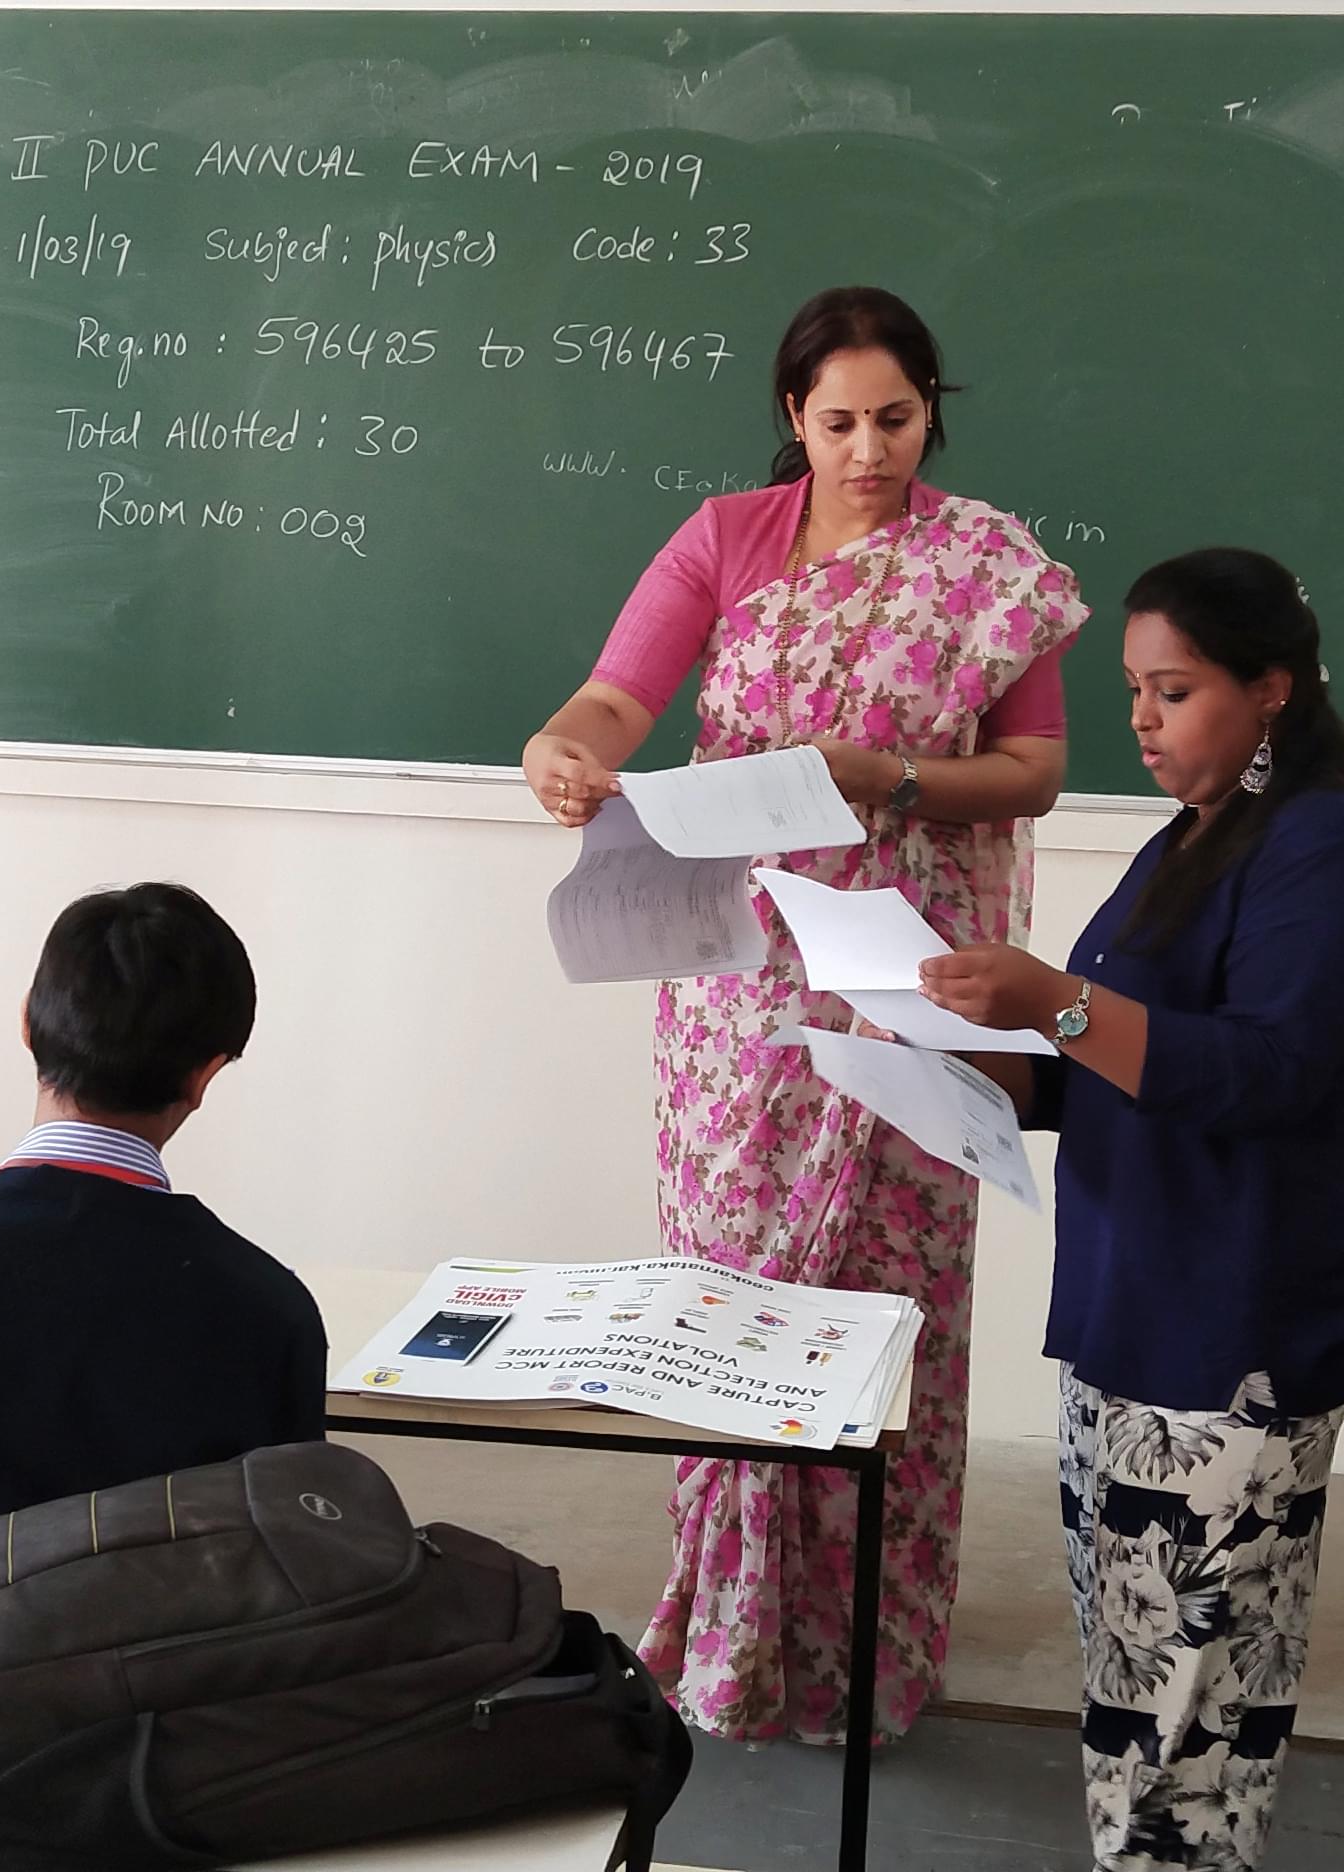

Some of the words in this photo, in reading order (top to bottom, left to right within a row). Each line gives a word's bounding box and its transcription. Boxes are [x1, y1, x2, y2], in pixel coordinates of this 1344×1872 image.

[85, 140, 159, 191] PUC
[195, 140, 366, 177] ANNUAL
[409, 141, 539, 183] EXAM
[602, 149, 703, 201] 2019
[17, 213, 132, 279] 1/03/19
[693, 223, 752, 264] 33
[255, 316, 439, 370] 596425
[479, 328, 525, 368] to
[552, 323, 736, 382] 596467
[56, 408, 143, 451] Total
[355, 415, 418, 456] 30
[280, 507, 367, 557] 002
[495, 1360, 550, 1370] MCC
[503, 1346, 653, 1360] EXPENDITURE
[603, 1333, 739, 1368] VIOLATIONS
[554, 1359, 646, 1376] REPORT
[651, 1370, 703, 1389] AND
[657, 1354, 769, 1390] ELECTION
[611, 1384, 663, 1401] B.PAC
[707, 1384, 816, 1412] CAPTURE
[775, 1384, 827, 1398] AND
